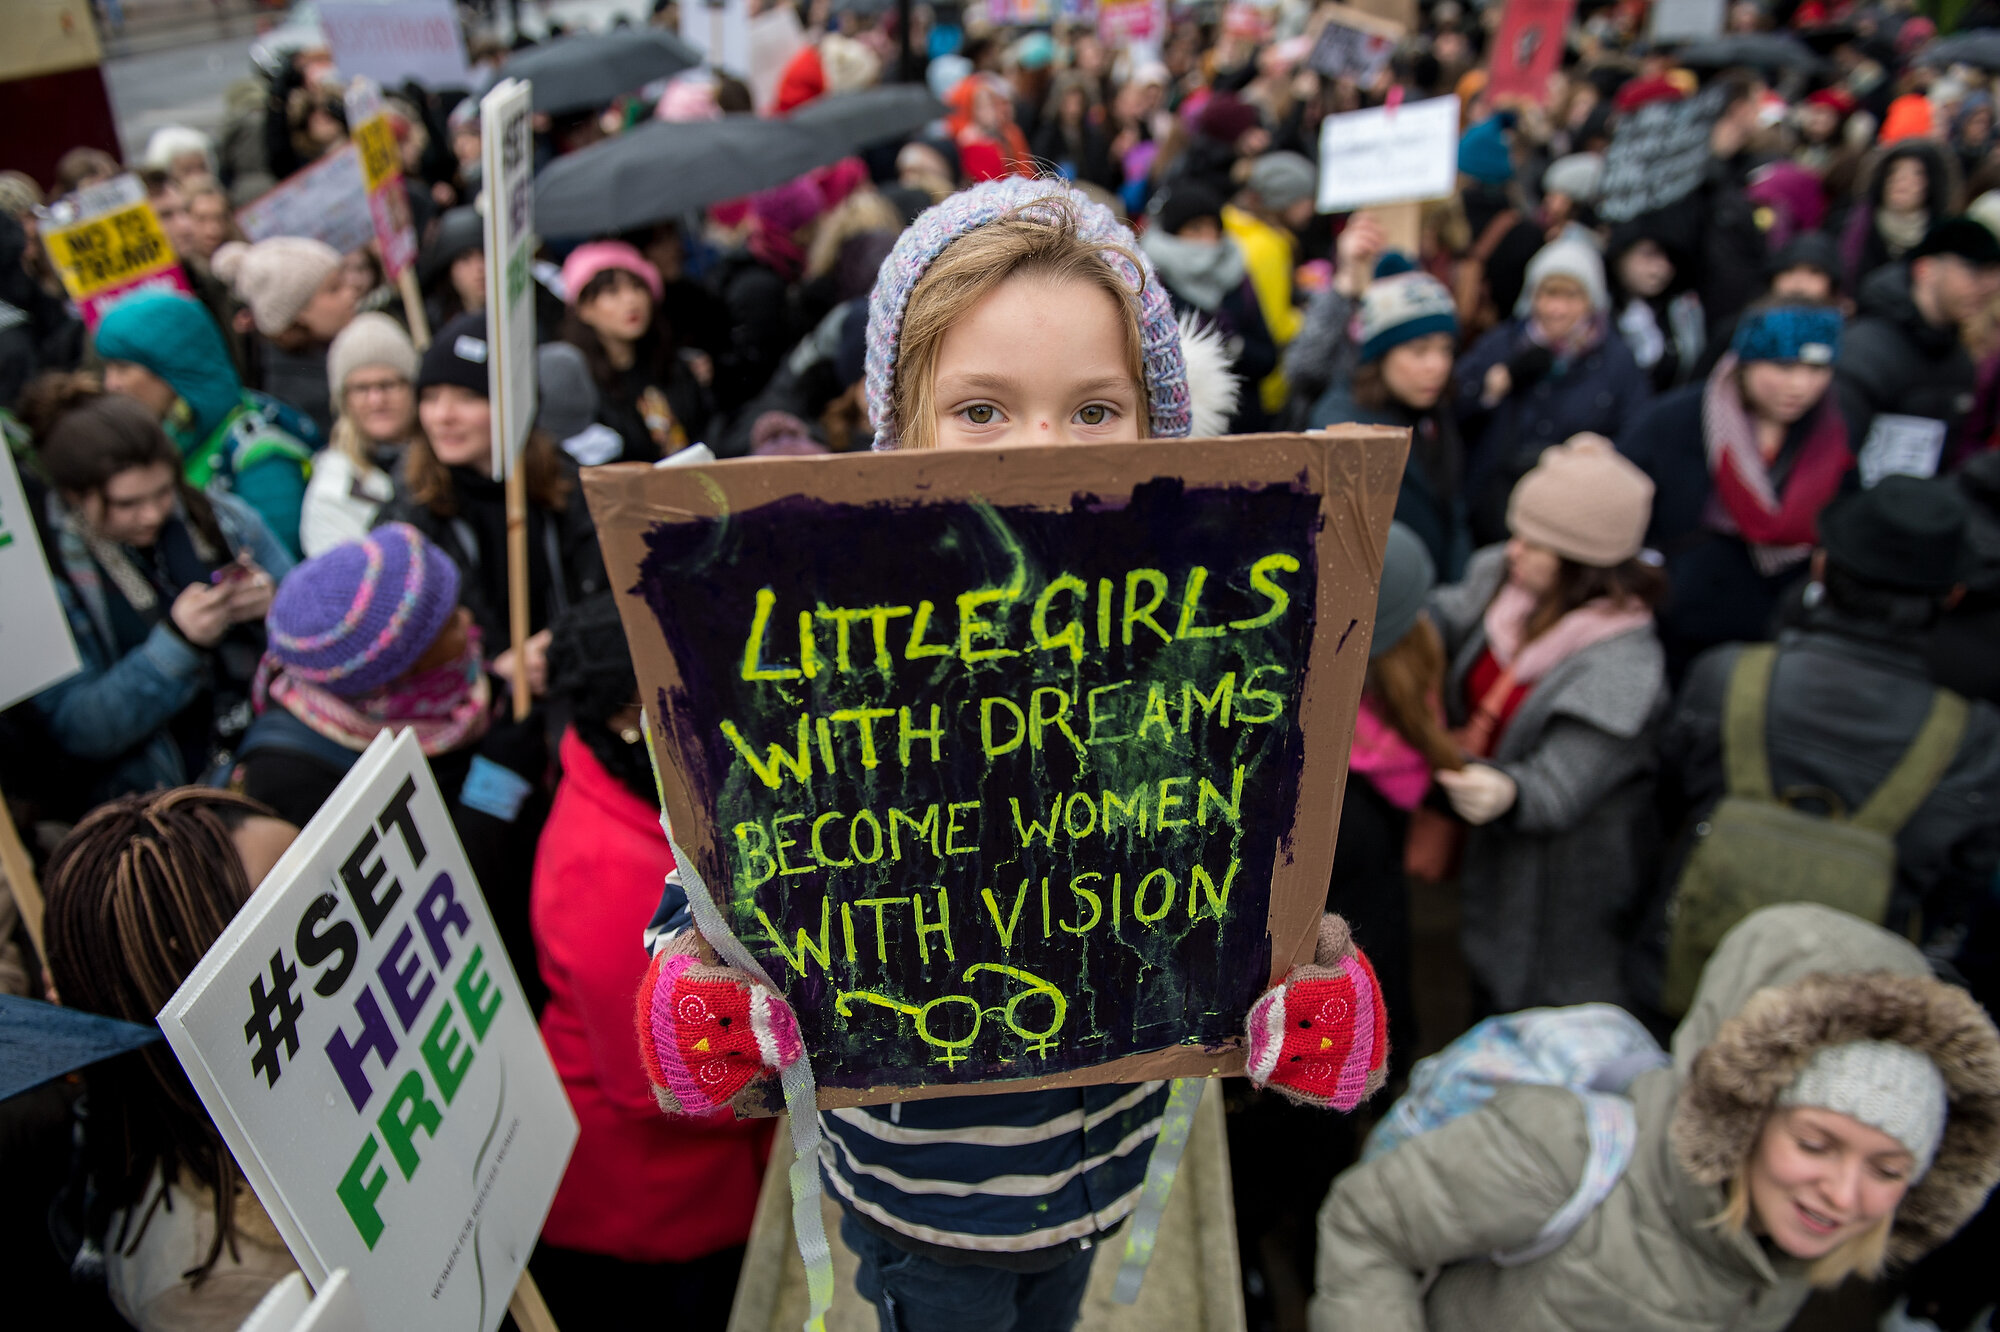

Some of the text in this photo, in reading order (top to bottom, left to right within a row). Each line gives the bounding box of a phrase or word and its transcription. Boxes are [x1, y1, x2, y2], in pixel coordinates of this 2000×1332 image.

[741, 553, 1300, 681] LITTLE GIRLS
[720, 664, 1286, 790] WITH DREAMS
[732, 764, 1245, 889] BECOME WOMEN
[244, 772, 427, 1089] #SET
[325, 870, 471, 1115] HER
[755, 858, 1240, 978] WITH VISION
[336, 944, 503, 1252] FREE
[431, 1117, 520, 1300] WOMEN FOR REFUGEE WOMEN
